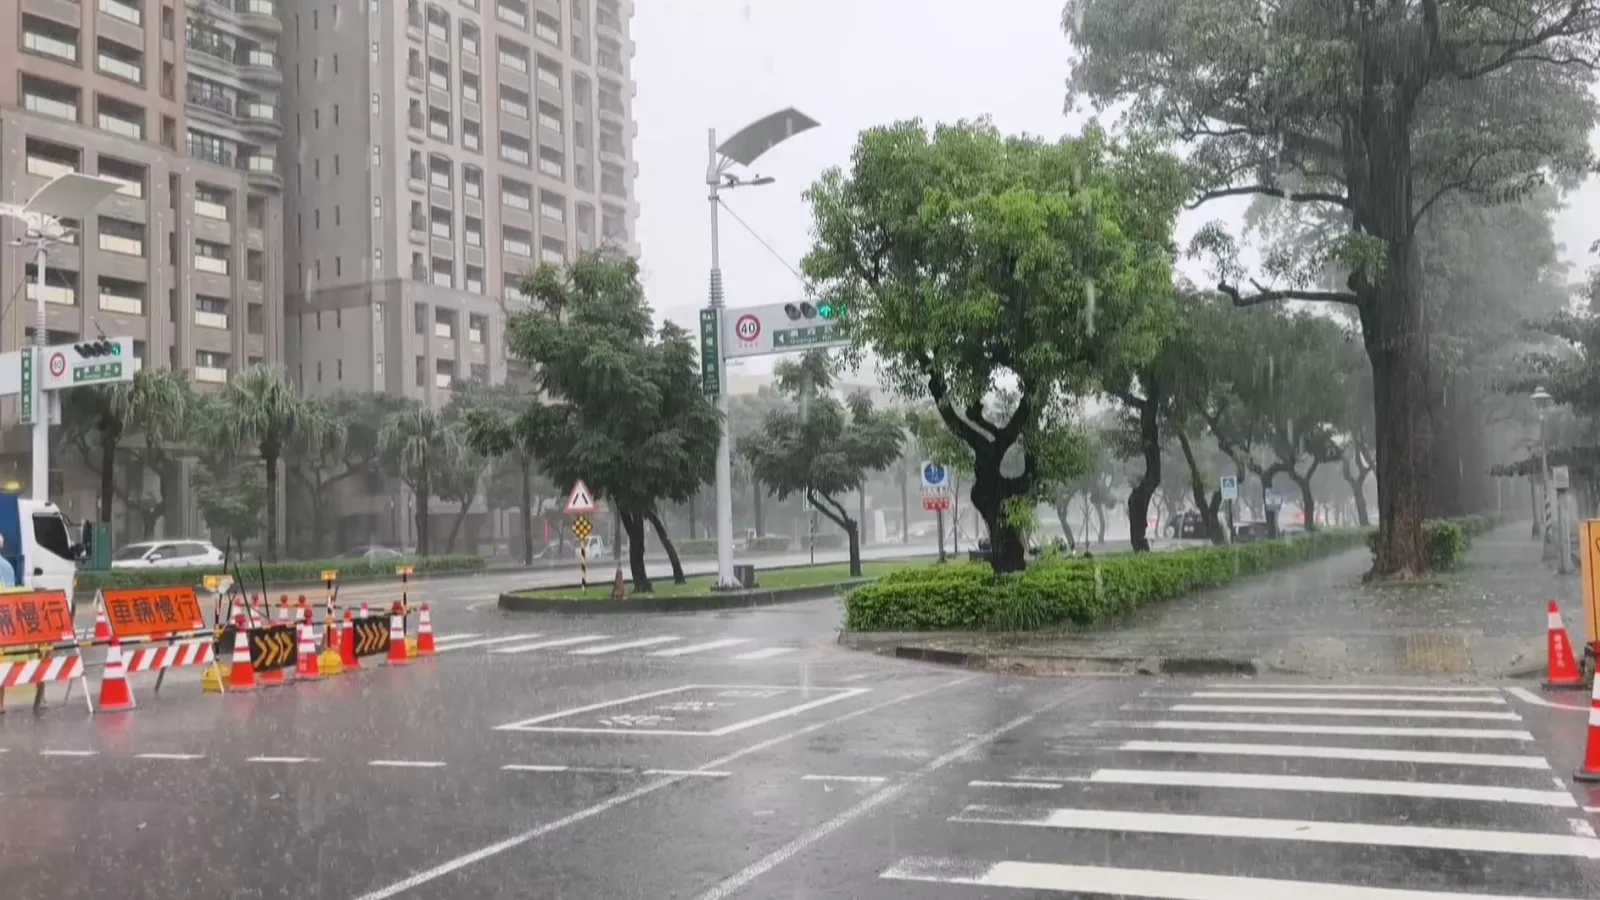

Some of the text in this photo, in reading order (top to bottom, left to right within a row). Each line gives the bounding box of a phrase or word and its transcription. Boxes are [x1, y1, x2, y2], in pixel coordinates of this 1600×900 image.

[741, 322, 756, 334] 40
[110, 594, 196, 625] 車輛慢行
